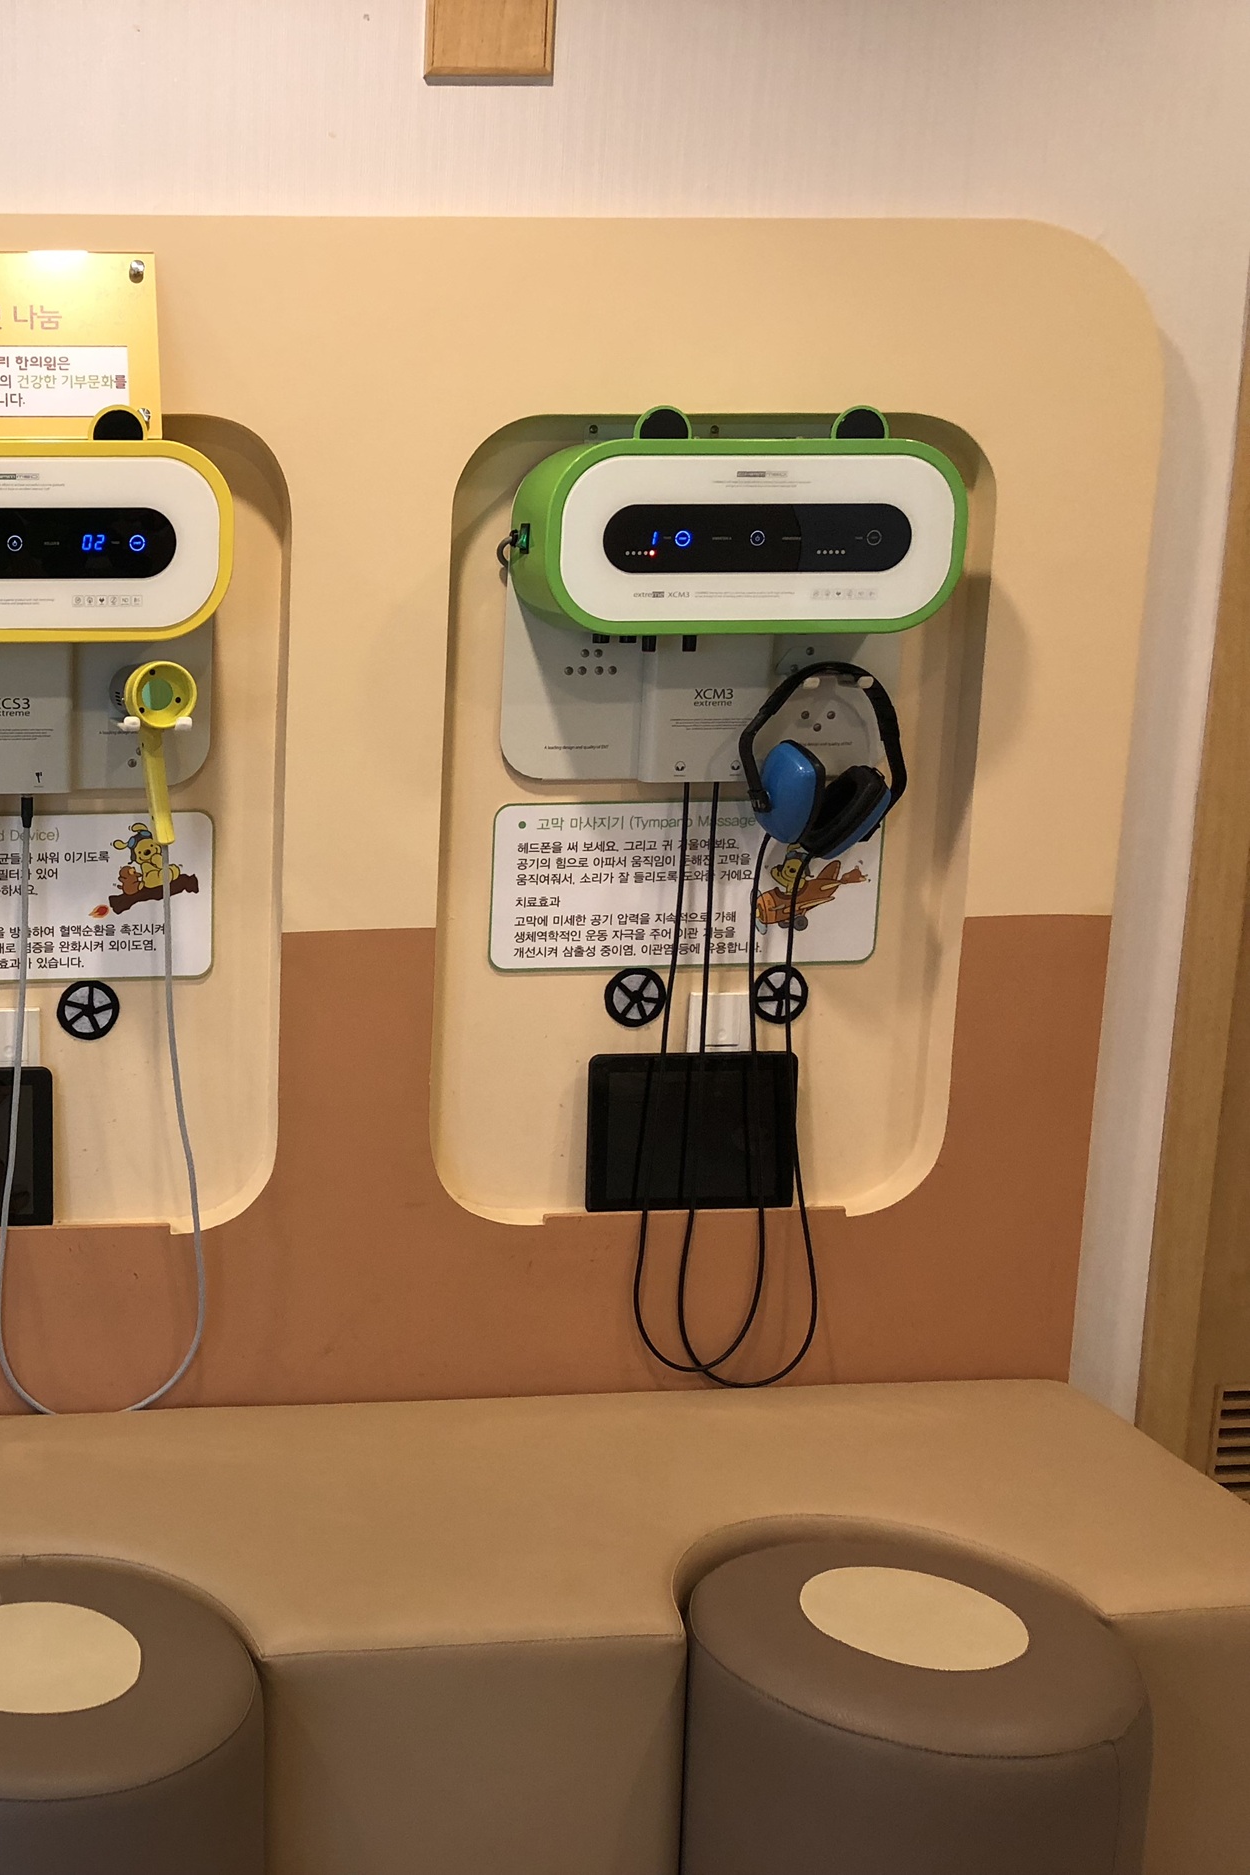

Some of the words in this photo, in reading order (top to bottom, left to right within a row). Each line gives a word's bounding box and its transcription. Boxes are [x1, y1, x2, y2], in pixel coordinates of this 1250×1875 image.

[12, 304, 63, 331] 나눔
[15, 355, 71, 372] 한의원은
[16, 374, 57, 390] 건강한
[61, 373, 128, 391] 기부문화를
[82, 534, 105, 551] 02
[633, 591, 665, 599] extreme
[694, 688, 734, 700] XCM3
[536, 816, 564, 831] 고막
[569, 815, 625, 830] 마사지기
[517, 841, 563, 854] 헤드폰을
[566, 841, 579, 853] 써
[582, 840, 619, 853] 보세요.
[623, 839, 658, 851] 그리고
[661, 839, 673, 851] 귀
[36, 851, 60, 864] 싸워
[64, 850, 111, 863] 이기도록
[516, 857, 551, 870] 공기의
[555, 856, 589, 869] 힘으로
[592, 855, 627, 868] 아파서
[631, 854, 676, 868] 움직임이
[717, 853, 751, 866] 고막을
[35, 868, 59, 880] 있어
[579, 872, 614, 885] 소리가
[618, 871, 630, 884] 잘
[633, 870, 678, 883] 들리도록
[515, 896, 561, 908] 치료효과
[514, 915, 548, 928] 고막에
[552, 914, 586, 927] 미세한
[590, 914, 613, 926] 공기
[617, 912, 651, 926] 압력을
[714, 910, 737, 923] 가해
[59, 924, 116, 938] 혈액순환을
[120, 923, 165, 936] 촉진시켜
[513, 929, 582, 943] 생체역학적인
[585, 929, 608, 942] 운동
[611, 928, 646, 941] 자극을
[649, 928, 672, 940] 주어
[58, 939, 104, 952] 완화시켜
[513, 946, 559, 959] 개선시켜
[562, 945, 596, 958] 삼출성
[678, 942, 701, 955] 등에
[36, 956, 85, 969] 있습니다.
